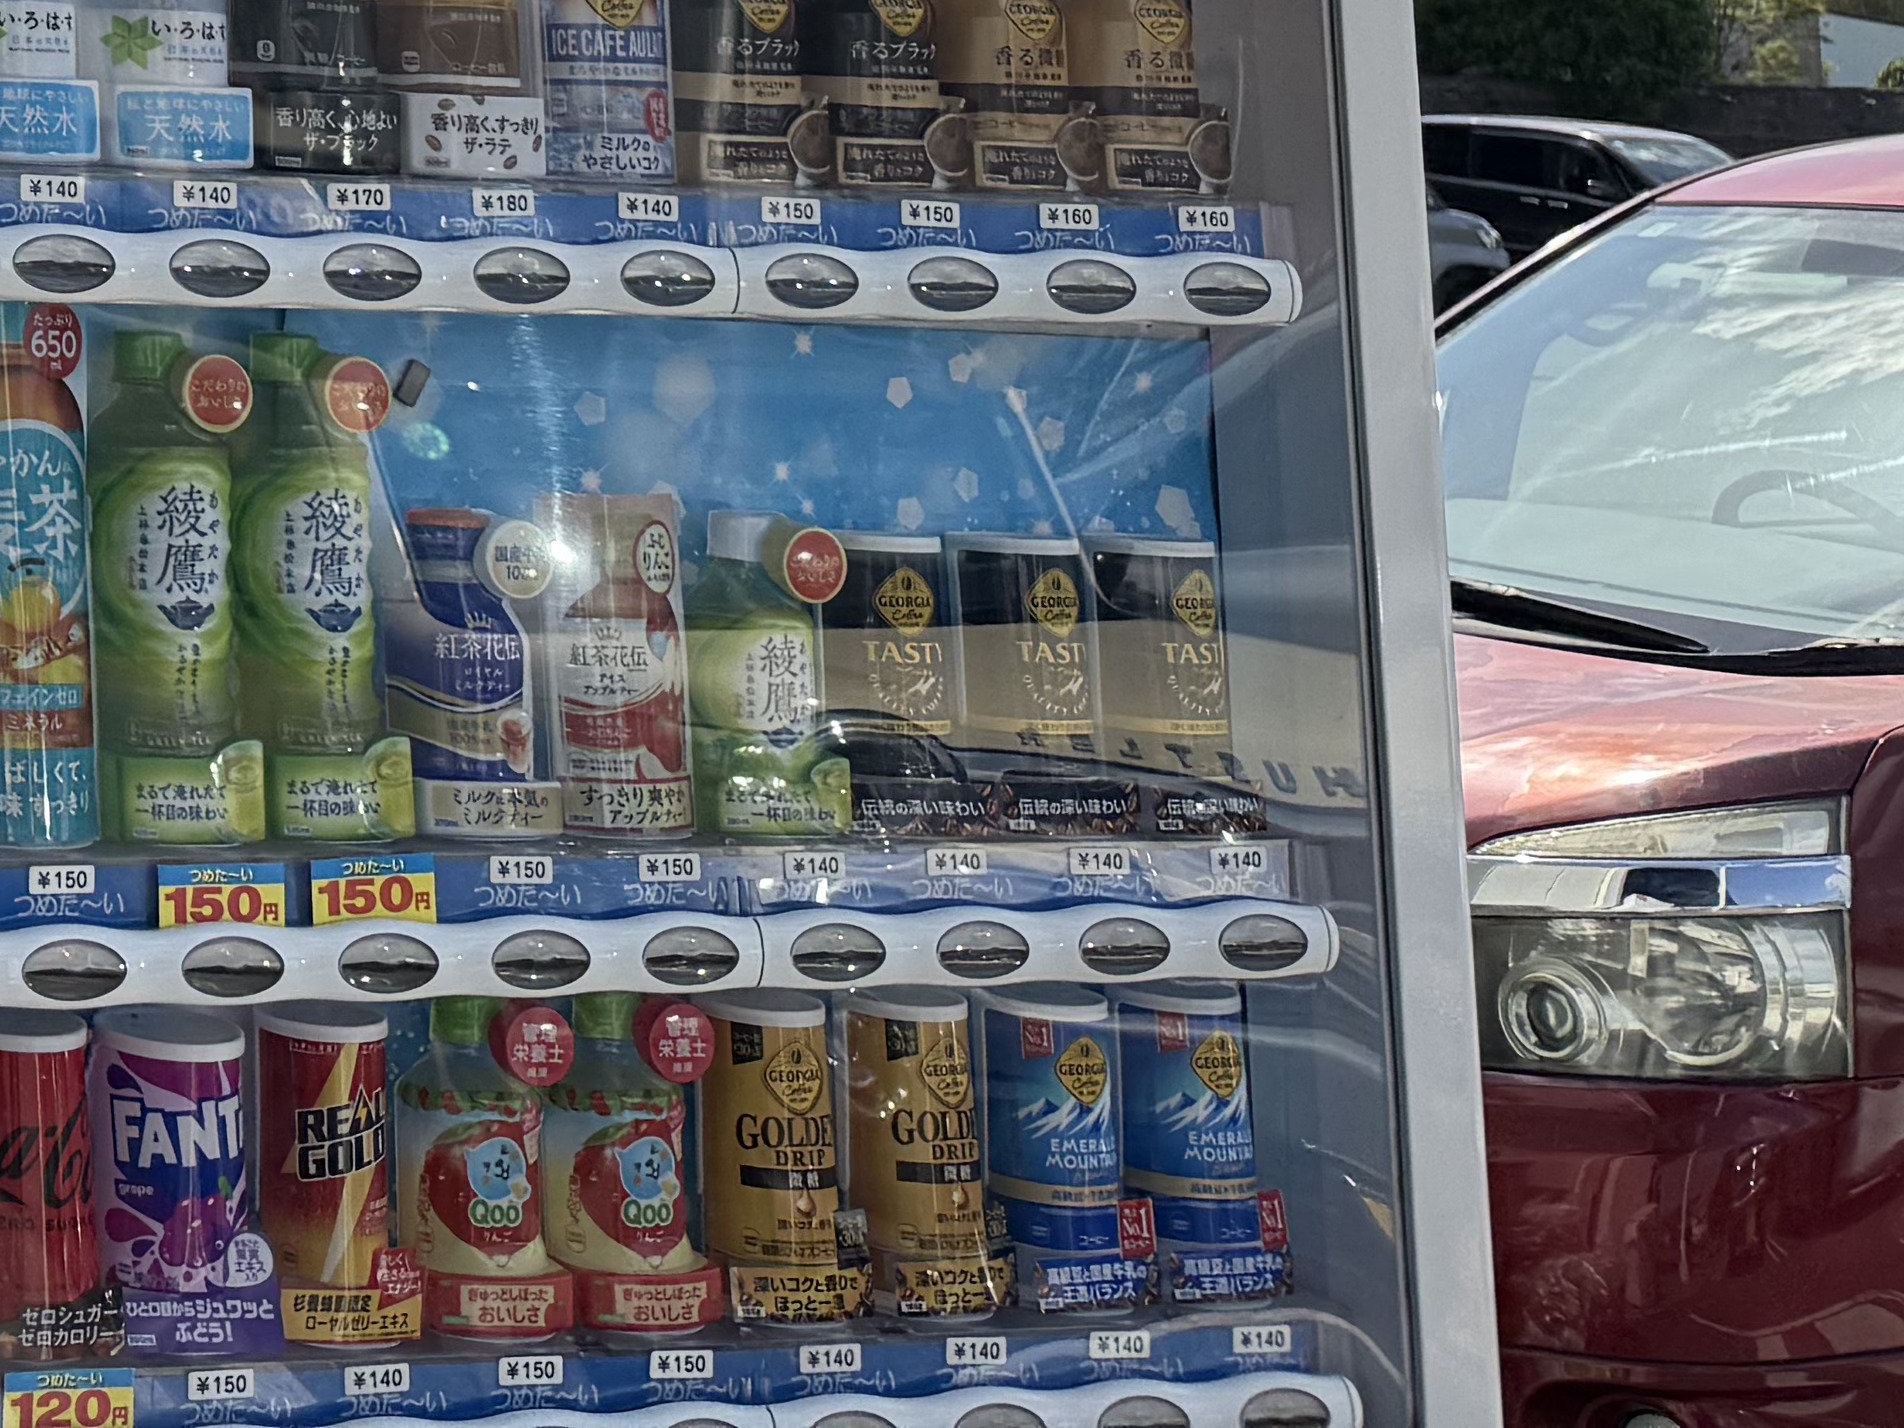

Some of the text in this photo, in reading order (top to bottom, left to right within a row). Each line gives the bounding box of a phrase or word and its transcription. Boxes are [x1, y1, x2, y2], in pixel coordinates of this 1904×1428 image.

[551, 28, 578, 57] ICE
[581, 28, 626, 57] CAFE
[145, 115, 233, 143] 天然水
[431, 113, 540, 135] 香り高く、すっきり
[463, 138, 512, 154] ザ・ラテ
[581, 154, 660, 171] やさしいコク
[30, 180, 79, 198] ¥140
[183, 185, 230, 203] ¥140
[336, 189, 384, 207] ¥170
[481, 193, 528, 211] ¥180
[626, 197, 671, 216] ¥140
[768, 202, 813, 220] ¥150
[909, 203, 953, 223] ¥150
[1048, 208, 1092, 225] ¥160
[1186, 211, 1228, 227] ¥160
[33, 313, 72, 327] たっぷり
[31, 330, 77, 358] 650
[155, 483, 208, 595] 綾鷹
[303, 488, 353, 597] 綾鷹
[436, 633, 520, 661] 紅茶花伝
[569, 643, 648, 668] 紅茶花伝
[760, 634, 798, 723] 綾鷹
[7, 716, 62, 731] ミネラル
[646, 858, 693, 876] ¥150
[794, 857, 839, 874] ¥140
[935, 853, 980, 871] ¥140
[1079, 853, 1122, 870] ¥140
[1219, 851, 1261, 869] ¥140
[498, 861, 545, 879] ¥150
[38, 871, 87, 889] ¥150
[165, 885, 279, 925] 150円
[318, 876, 430, 917] 150円
[512, 1045, 564, 1064] 栄養士
[658, 1038, 706, 1058] 栄養士
[113, 1096, 243, 1168] FANT
[776, 1149, 825, 1167] DRIP
[932, 1143, 975, 1161] DRIP
[118, 1182, 154, 1197] grape
[469, 1199, 521, 1226] Qoo
[623, 1199, 672, 1226] Qoo
[468, 1288, 549, 1303] ぎゅっとしぼった
[623, 1286, 701, 1301] ぎゅっとしぼった
[22, 1306, 118, 1326] ゼロシュガー
[306, 1313, 409, 1330] ローヤルゼリーエキス
[479, 1305, 540, 1324] おいしさ
[634, 1305, 694, 1322] おいしさ
[1098, 1336, 1143, 1354] ¥140
[1241, 1330, 1285, 1348] ¥140
[808, 1349, 853, 1366] ¥140
[954, 1342, 999, 1361] ¥140
[507, 1362, 555, 1379] ¥150
[658, 1355, 705, 1373] ¥150
[197, 1375, 247, 1394] ¥150
[353, 1369, 402, 1389] ¥140
[11, 1390, 128, 1428] 120円
